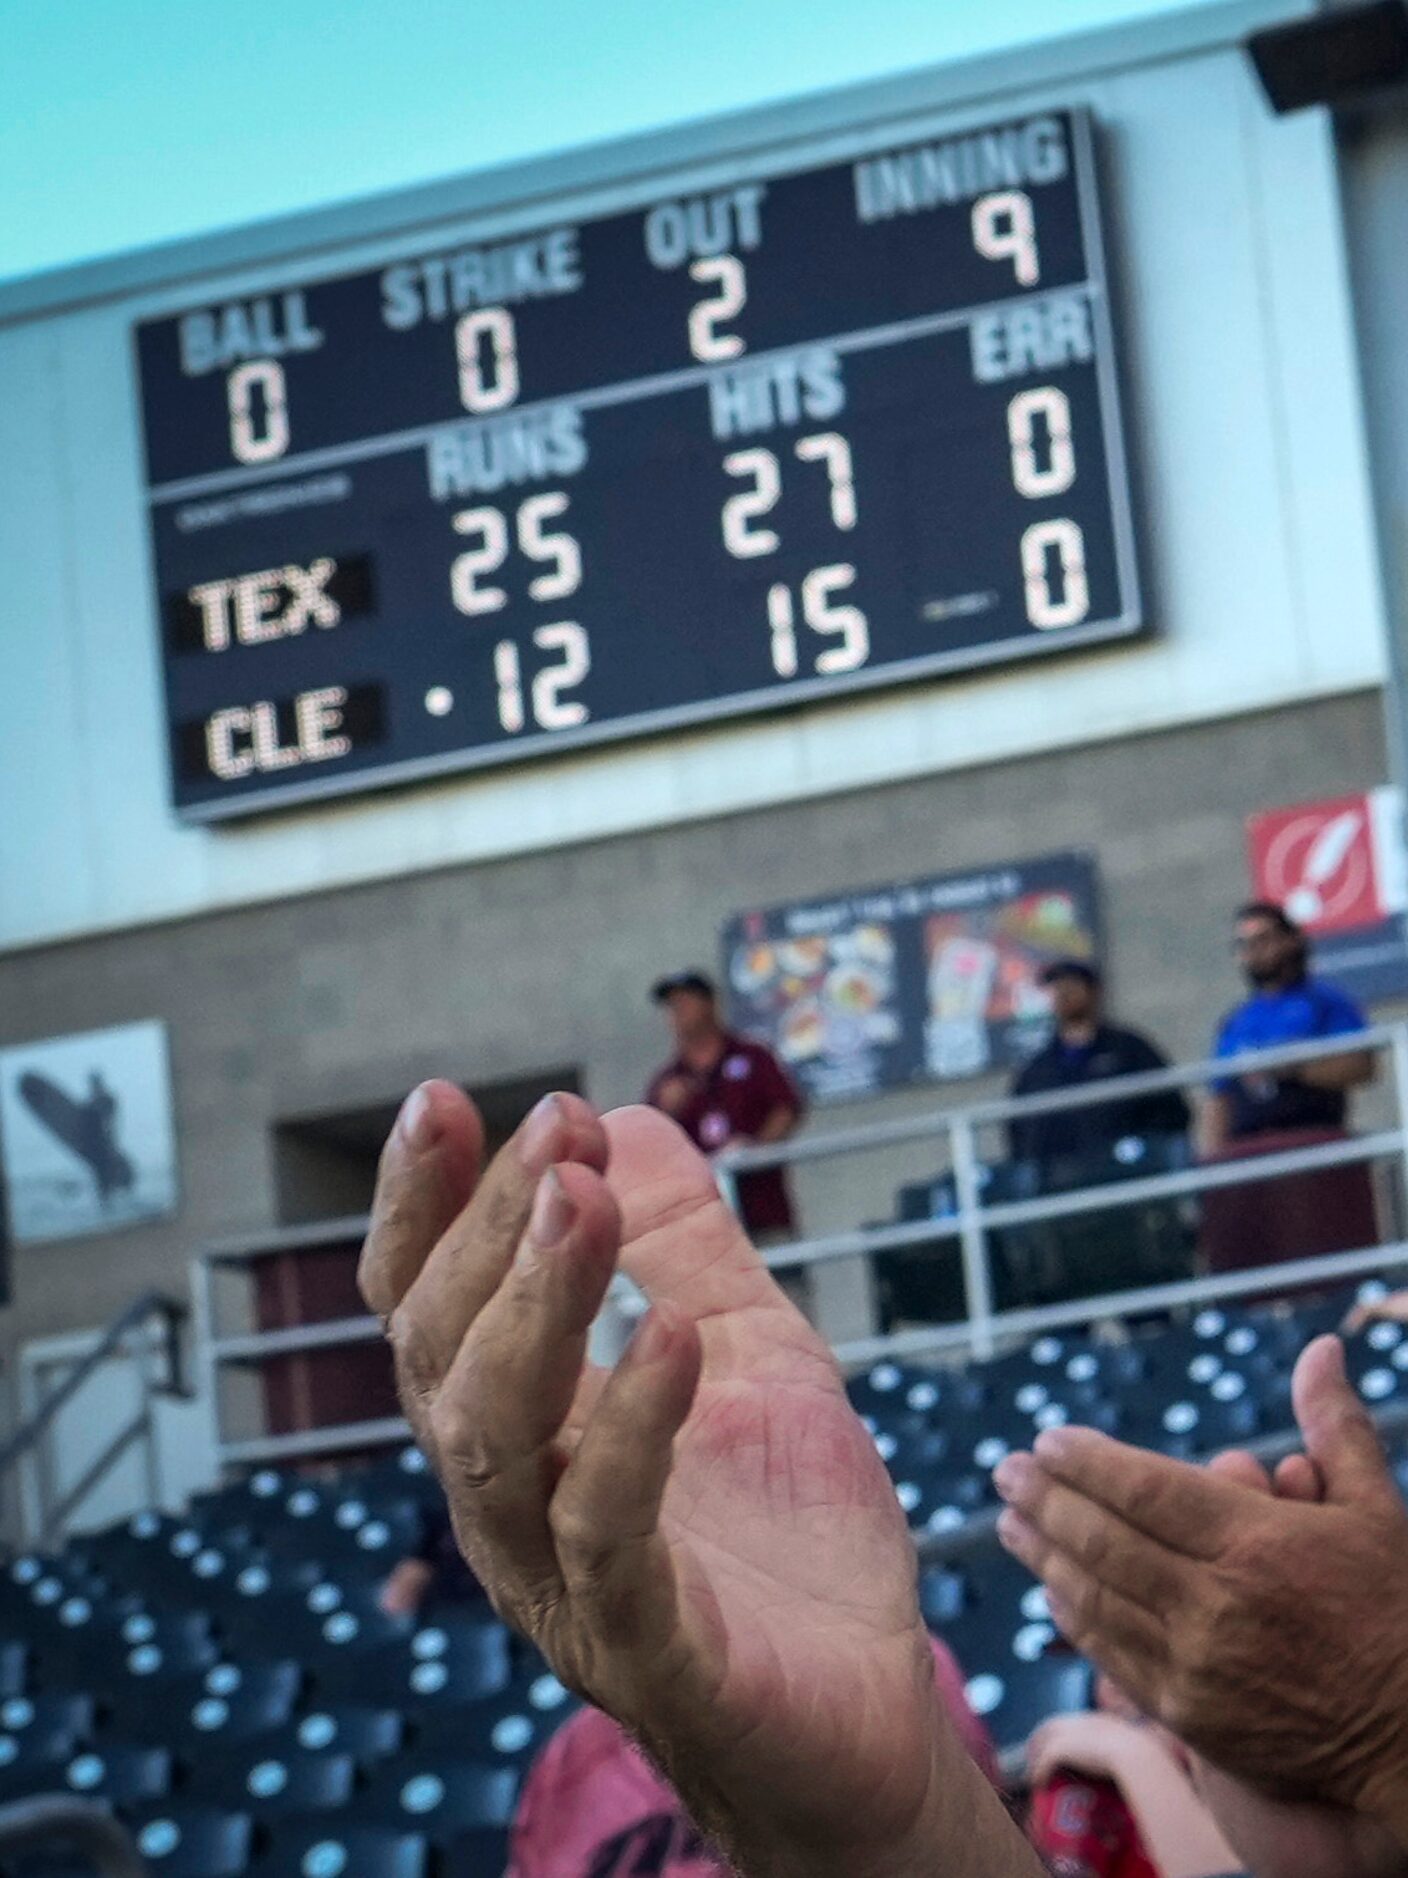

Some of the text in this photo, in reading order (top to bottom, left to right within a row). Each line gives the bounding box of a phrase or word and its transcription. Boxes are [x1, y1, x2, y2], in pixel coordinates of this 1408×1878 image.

[854, 117, 1069, 225] INNING
[380, 227, 583, 330] STRIKE
[645, 185, 766, 271] OUT
[971, 191, 1040, 287] 9
[179, 292, 323, 377] BALL
[689, 253, 746, 361] 2
[968, 299, 1096, 384] ERR
[227, 359, 290, 464] 0
[454, 307, 519, 414] 0
[708, 348, 845, 440] HITS
[427, 406, 588, 501] RUNS
[1008, 386, 1076, 499] 0
[721, 432, 858, 560] 27
[188, 556, 341, 653] TEX
[450, 491, 583, 616] 25
[1020, 517, 1090, 630] 0
[767, 562, 871, 679] 15
[493, 620, 591, 732] 12
[205, 686, 352, 781] CLE
